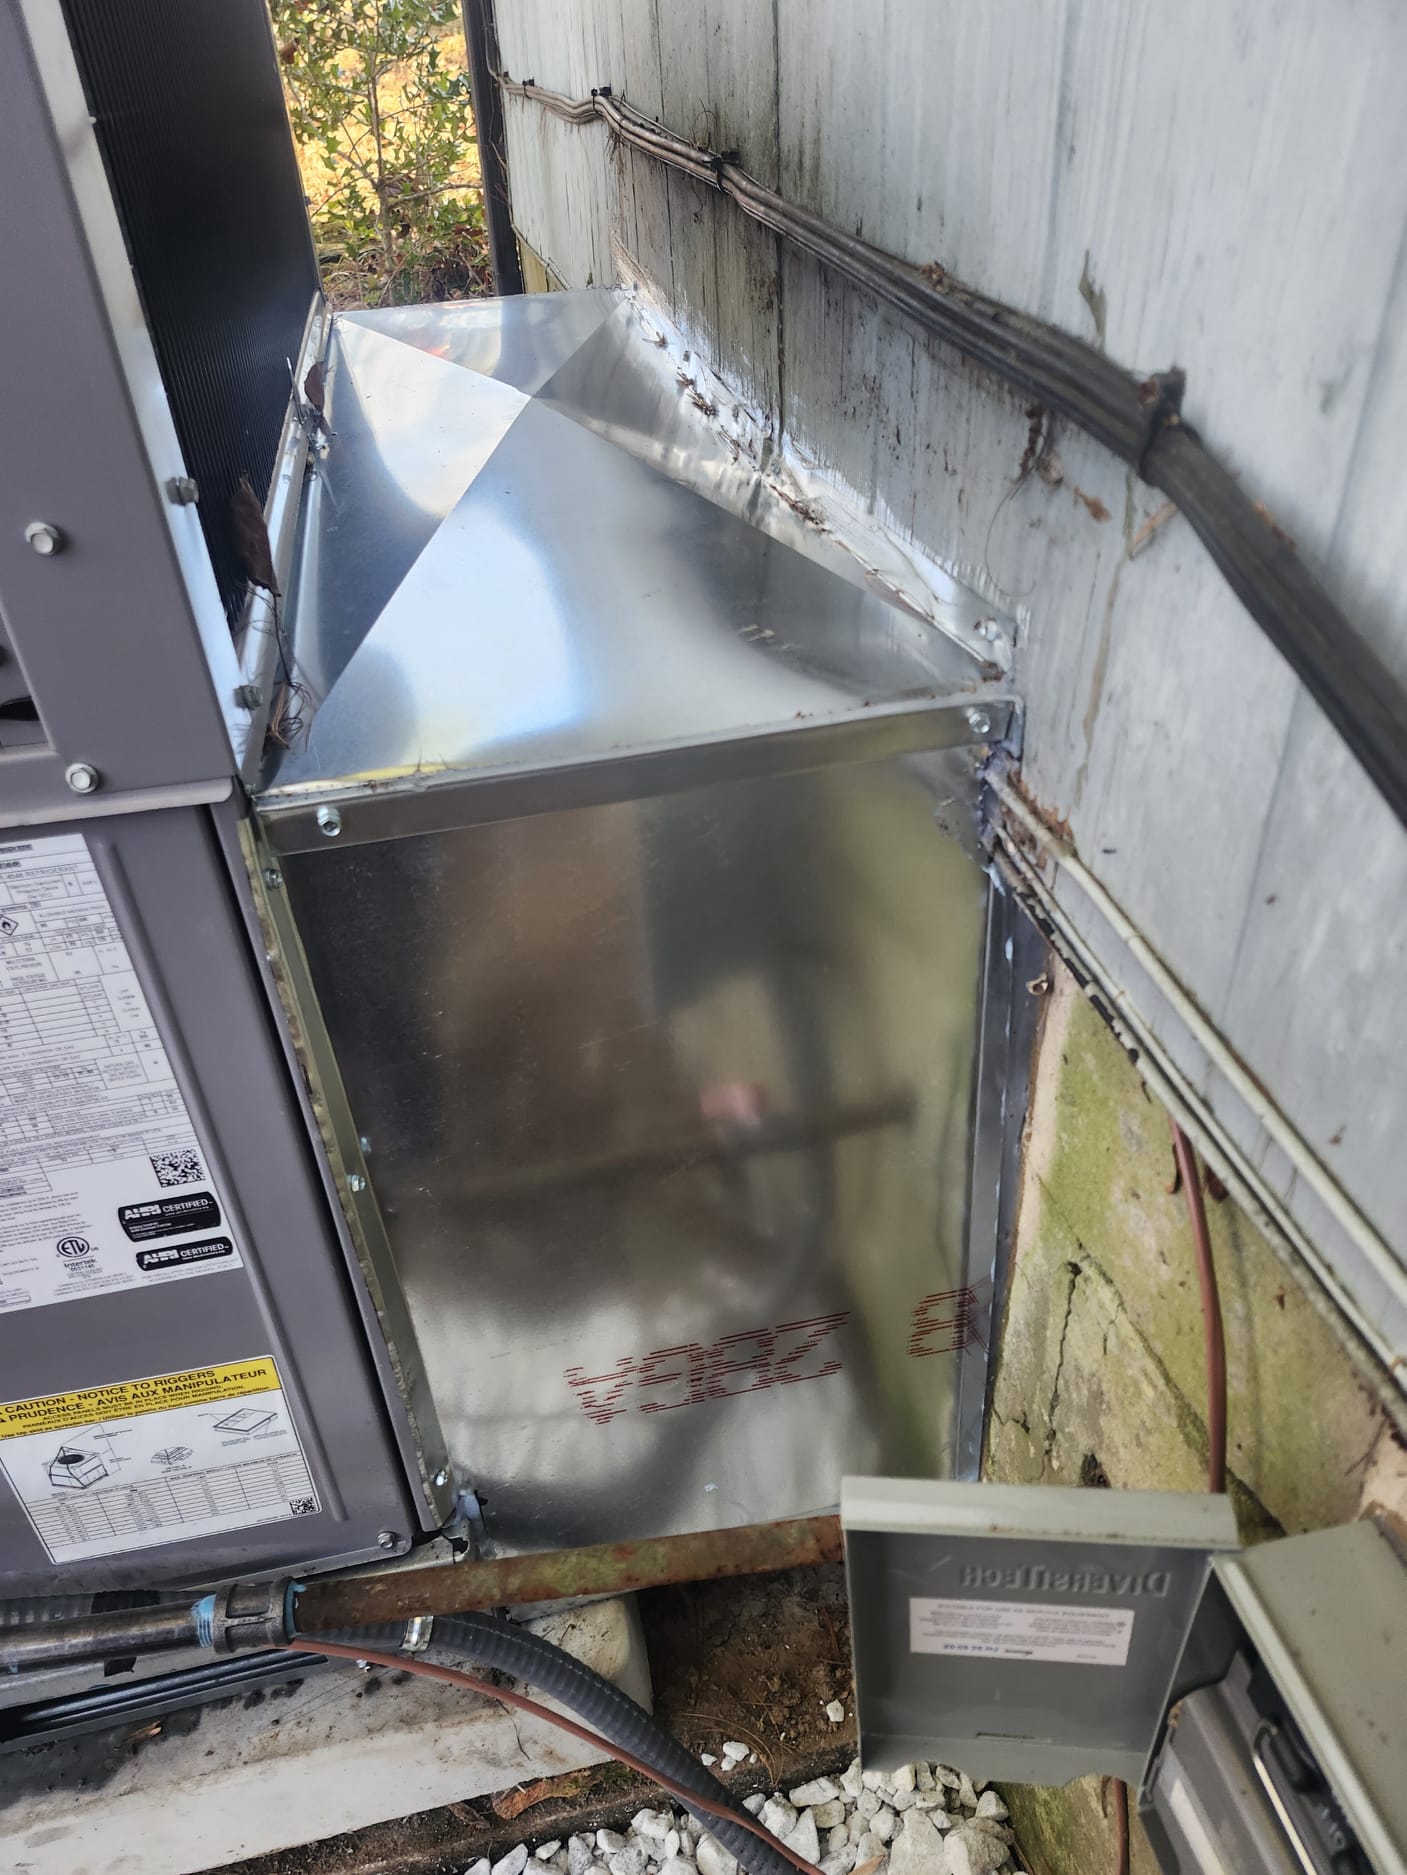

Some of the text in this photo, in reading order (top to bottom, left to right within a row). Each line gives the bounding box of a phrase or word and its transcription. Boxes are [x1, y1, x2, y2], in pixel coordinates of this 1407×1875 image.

[124, 1198, 208, 1220] AHRI CERTIFIED
[144, 1244, 225, 1264] AHRI CERTIFIED
[5, 1397, 65, 1414] CAUTION
[77, 1386, 129, 1401] NOTICE
[132, 1382, 150, 1390] TO
[154, 1370, 216, 1387] RIGGERS
[9, 1402, 85, 1423] PRUDENCE
[97, 1394, 128, 1406] AVIS
[132, 1388, 159, 1400] AUX
[162, 1369, 267, 1394] MANIPULATEUR
